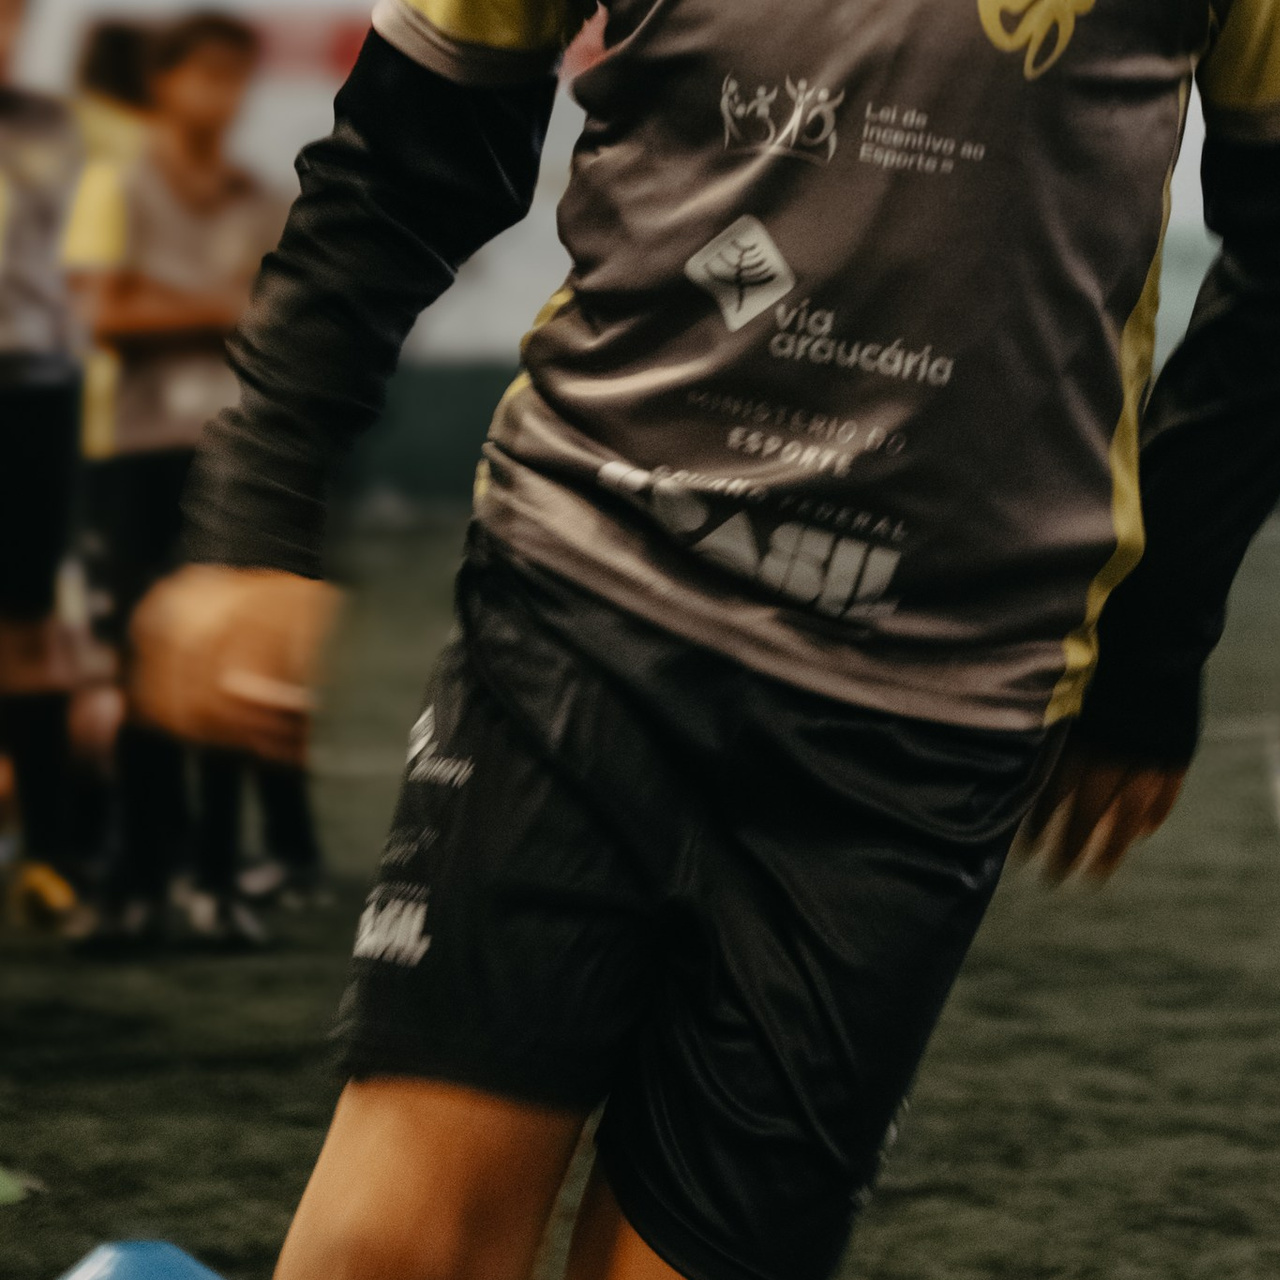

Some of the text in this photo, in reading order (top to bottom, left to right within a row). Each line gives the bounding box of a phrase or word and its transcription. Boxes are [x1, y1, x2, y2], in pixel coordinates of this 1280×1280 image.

[862, 122, 956, 155] Incentivo
[858, 142, 938, 175] Esporte
[769, 332, 954, 386] araucária
